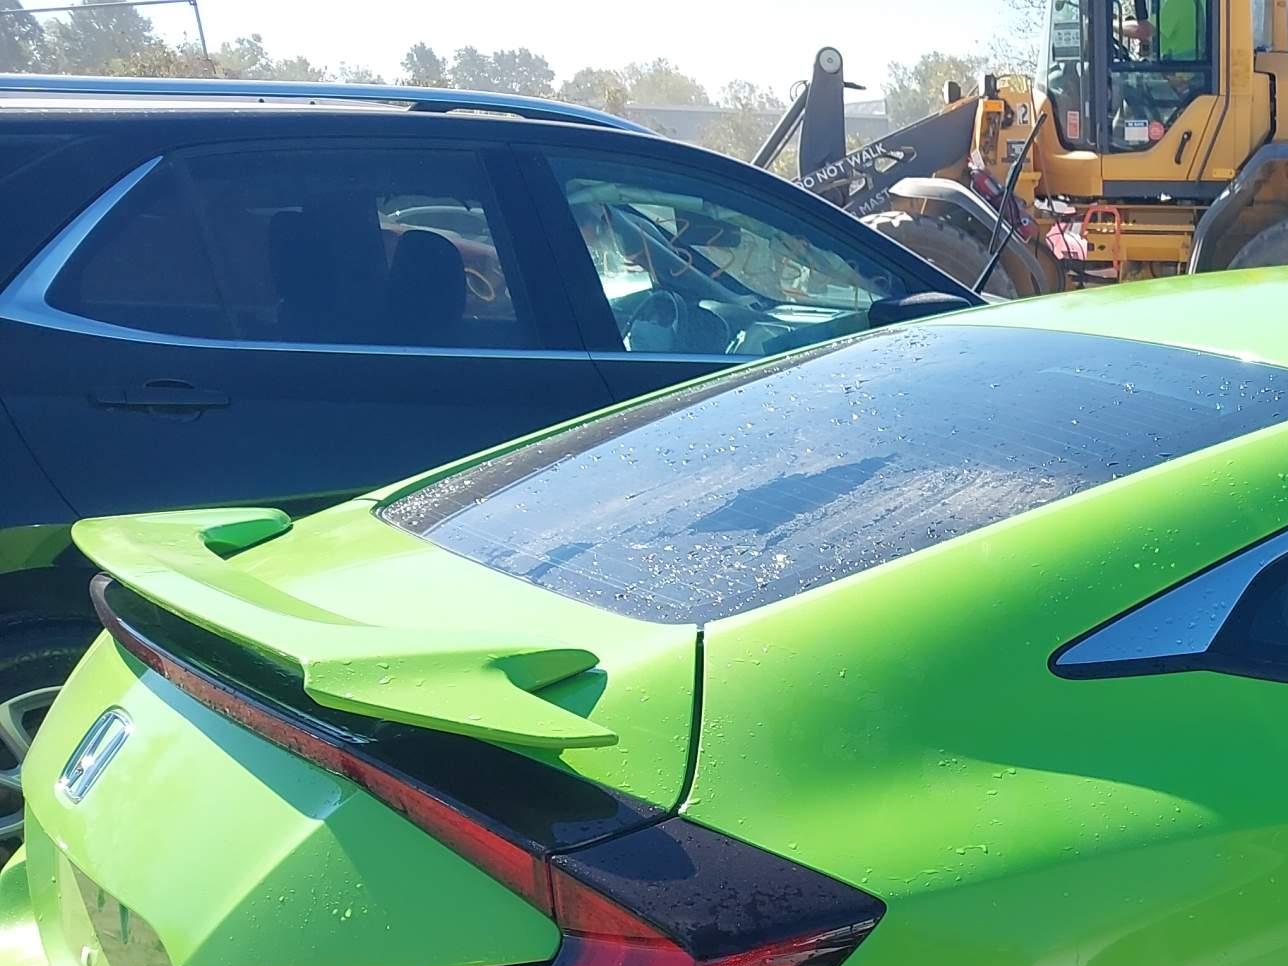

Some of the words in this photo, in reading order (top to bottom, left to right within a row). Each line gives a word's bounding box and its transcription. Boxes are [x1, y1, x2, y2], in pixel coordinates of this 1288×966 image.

[816, 162, 846, 184] NOT
[846, 143, 887, 168] WALK
[859, 187, 891, 215] MAST
